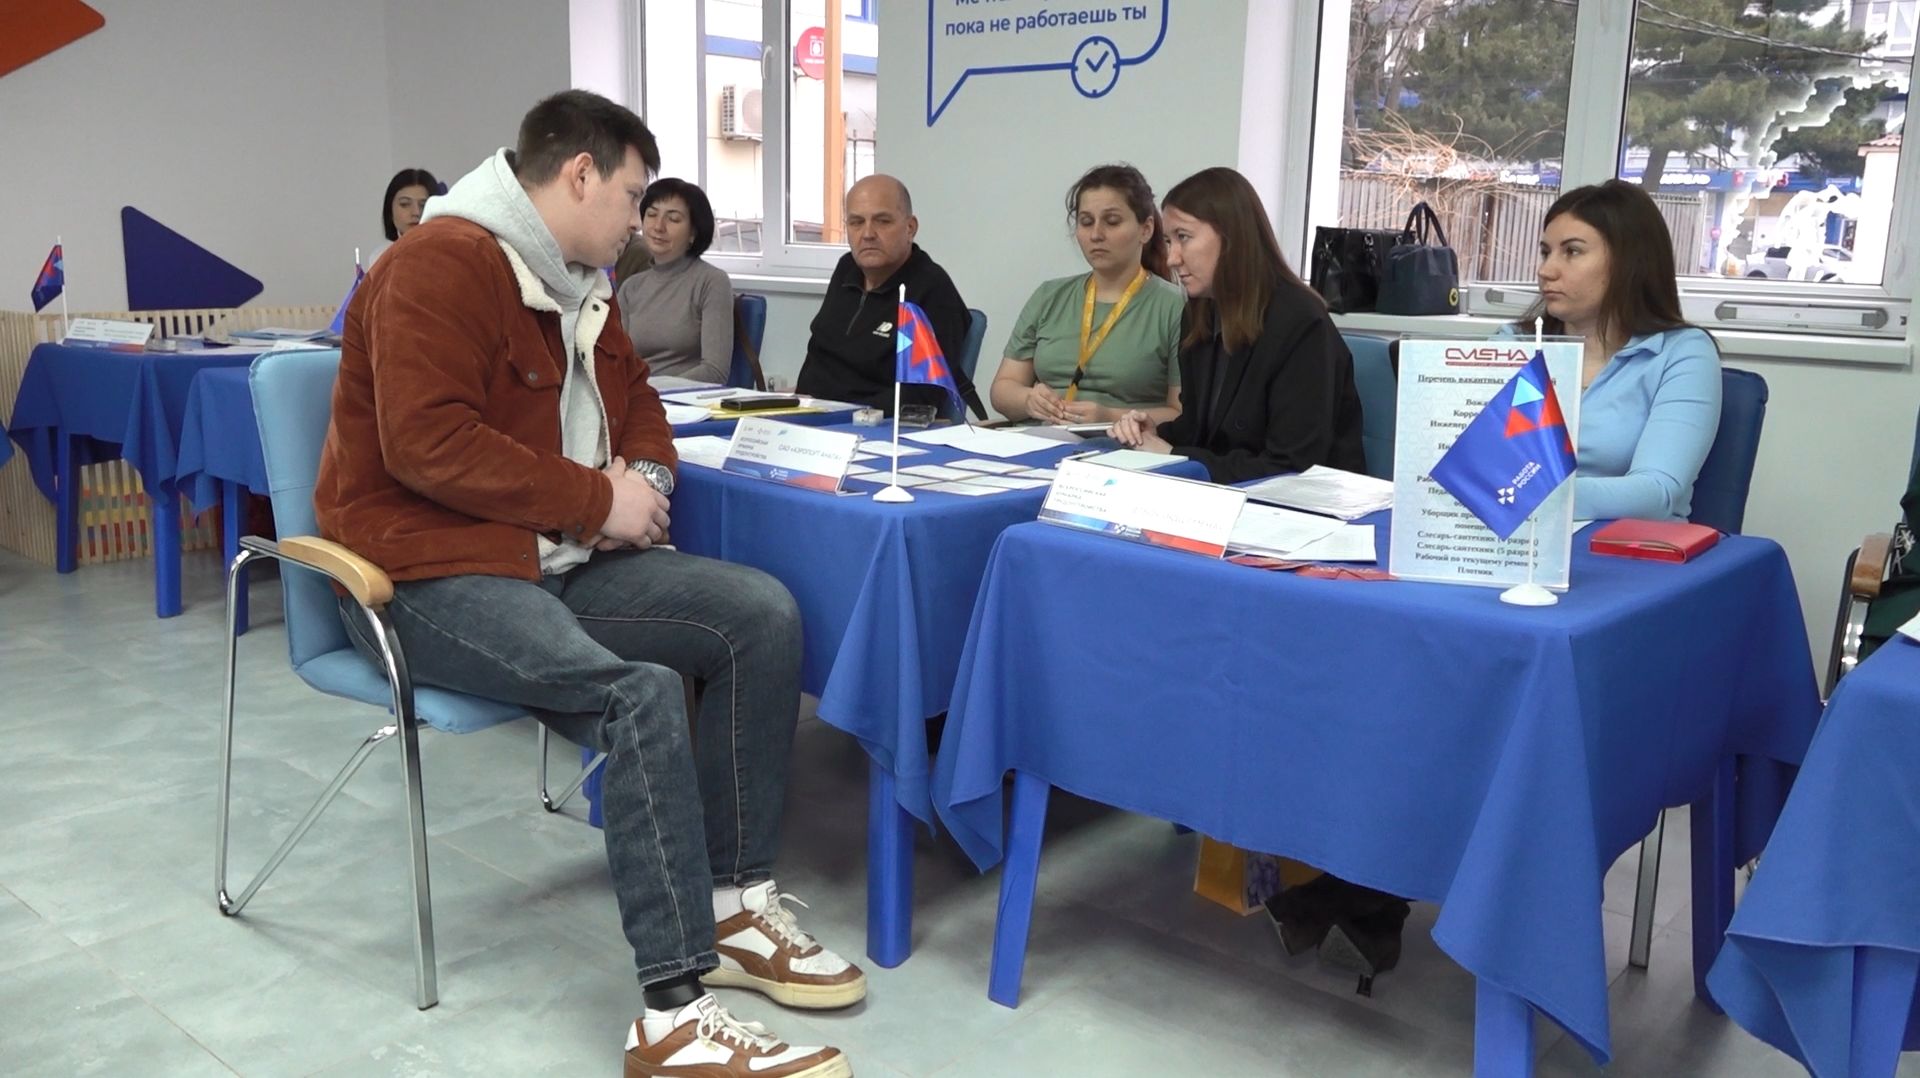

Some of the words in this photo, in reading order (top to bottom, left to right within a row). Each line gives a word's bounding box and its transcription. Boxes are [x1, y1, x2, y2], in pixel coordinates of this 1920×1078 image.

[945, 20, 984, 36] пока
[990, 18, 1011, 32] не
[1015, 8, 1117, 34] работаешь
[1122, 6, 1146, 20] ты
[1418, 375, 1457, 384] Перечень
[1458, 377, 1504, 385] вакантных
[1430, 420, 1467, 431] Инженер
[1512, 461, 1535, 485] РАБОТА
[1517, 463, 1541, 489] РОССИИ
[1421, 508, 1458, 519] Уборщик
[1417, 530, 1495, 544] Слесарь-сантехник
[1417, 541, 1495, 554] Слесарь-сантехник
[1415, 553, 1449, 562] Рабочий
[1462, 557, 1502, 566] текущему
[1504, 560, 1538, 569] ремону
[1457, 567, 1494, 576] Плотник
